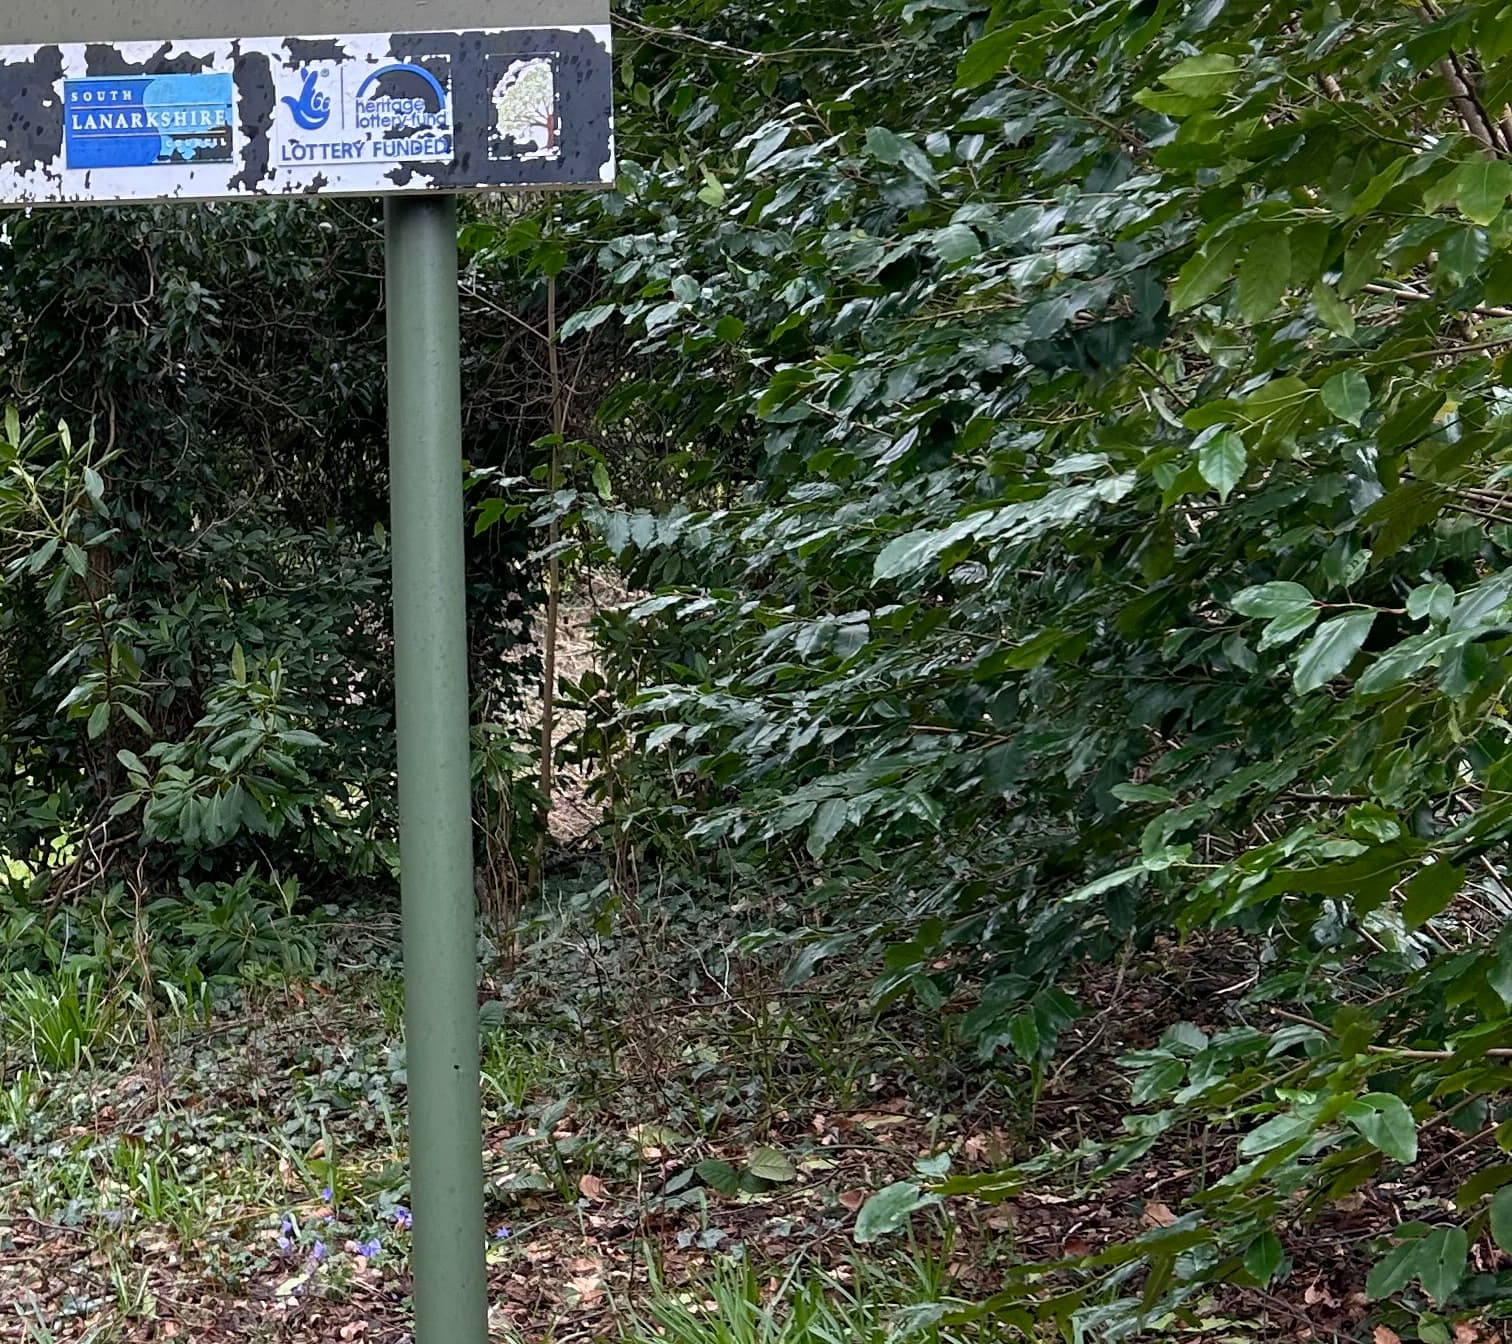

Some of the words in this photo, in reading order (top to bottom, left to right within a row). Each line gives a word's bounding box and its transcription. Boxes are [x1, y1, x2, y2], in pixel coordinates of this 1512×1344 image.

[71, 90, 133, 103] SOUTH
[356, 99, 425, 115] heritage
[72, 110, 226, 130] LANARKSHIRE
[282, 141, 365, 161] LOTTERY
[373, 137, 450, 157] FUNDED
